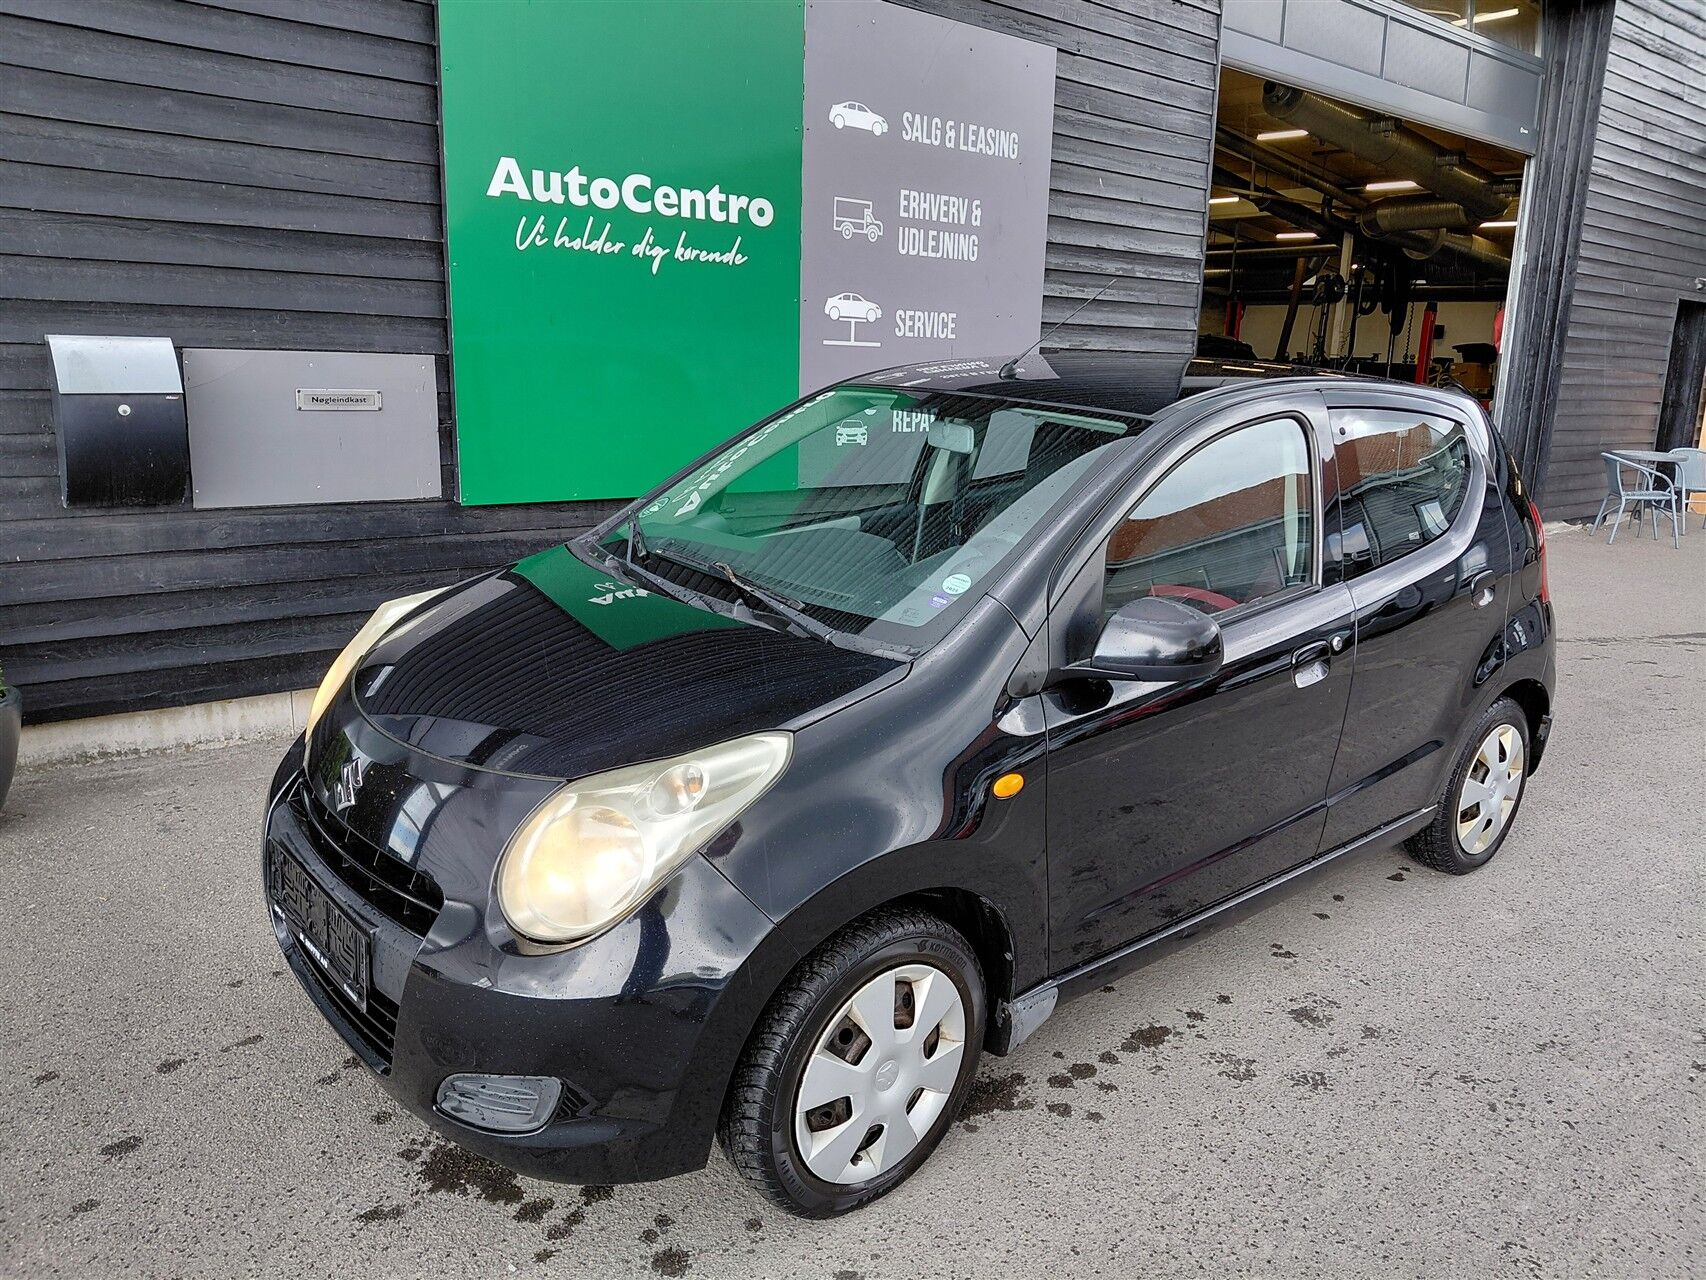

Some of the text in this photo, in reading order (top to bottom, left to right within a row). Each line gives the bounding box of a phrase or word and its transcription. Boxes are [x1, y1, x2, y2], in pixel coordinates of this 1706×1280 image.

[902, 111, 1019, 159] SALG & LEASING
[486, 156, 775, 227] AutoCentro
[899, 189, 982, 227] ERHVERV &
[515, 214, 748, 276] Vi holder dig kørende
[898, 226, 979, 262] UDLEJNING
[894, 309, 957, 339] SERVICE
[311, 396, 367, 405] Nøgleindkast
